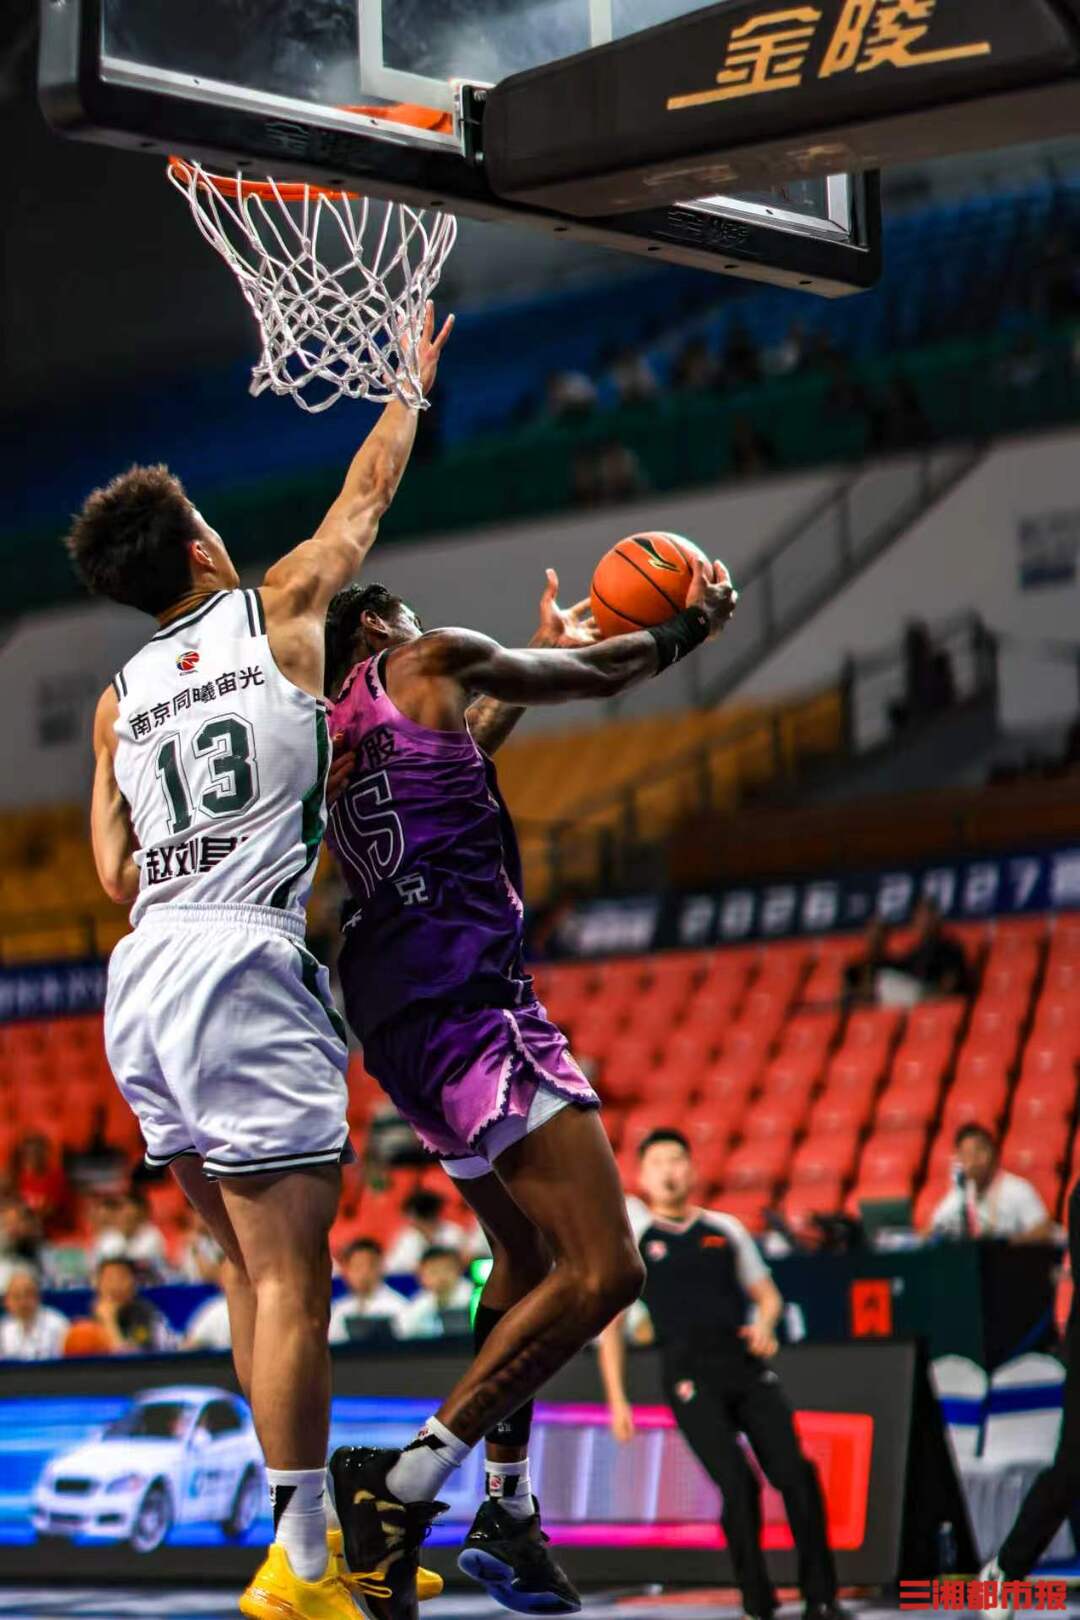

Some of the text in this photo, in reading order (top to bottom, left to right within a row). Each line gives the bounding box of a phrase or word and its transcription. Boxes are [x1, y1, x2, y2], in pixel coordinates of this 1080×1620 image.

[667, 0, 991, 110] 金陵
[129, 665, 266, 740] 南京同曦宙光
[155, 712, 260, 835] 13
